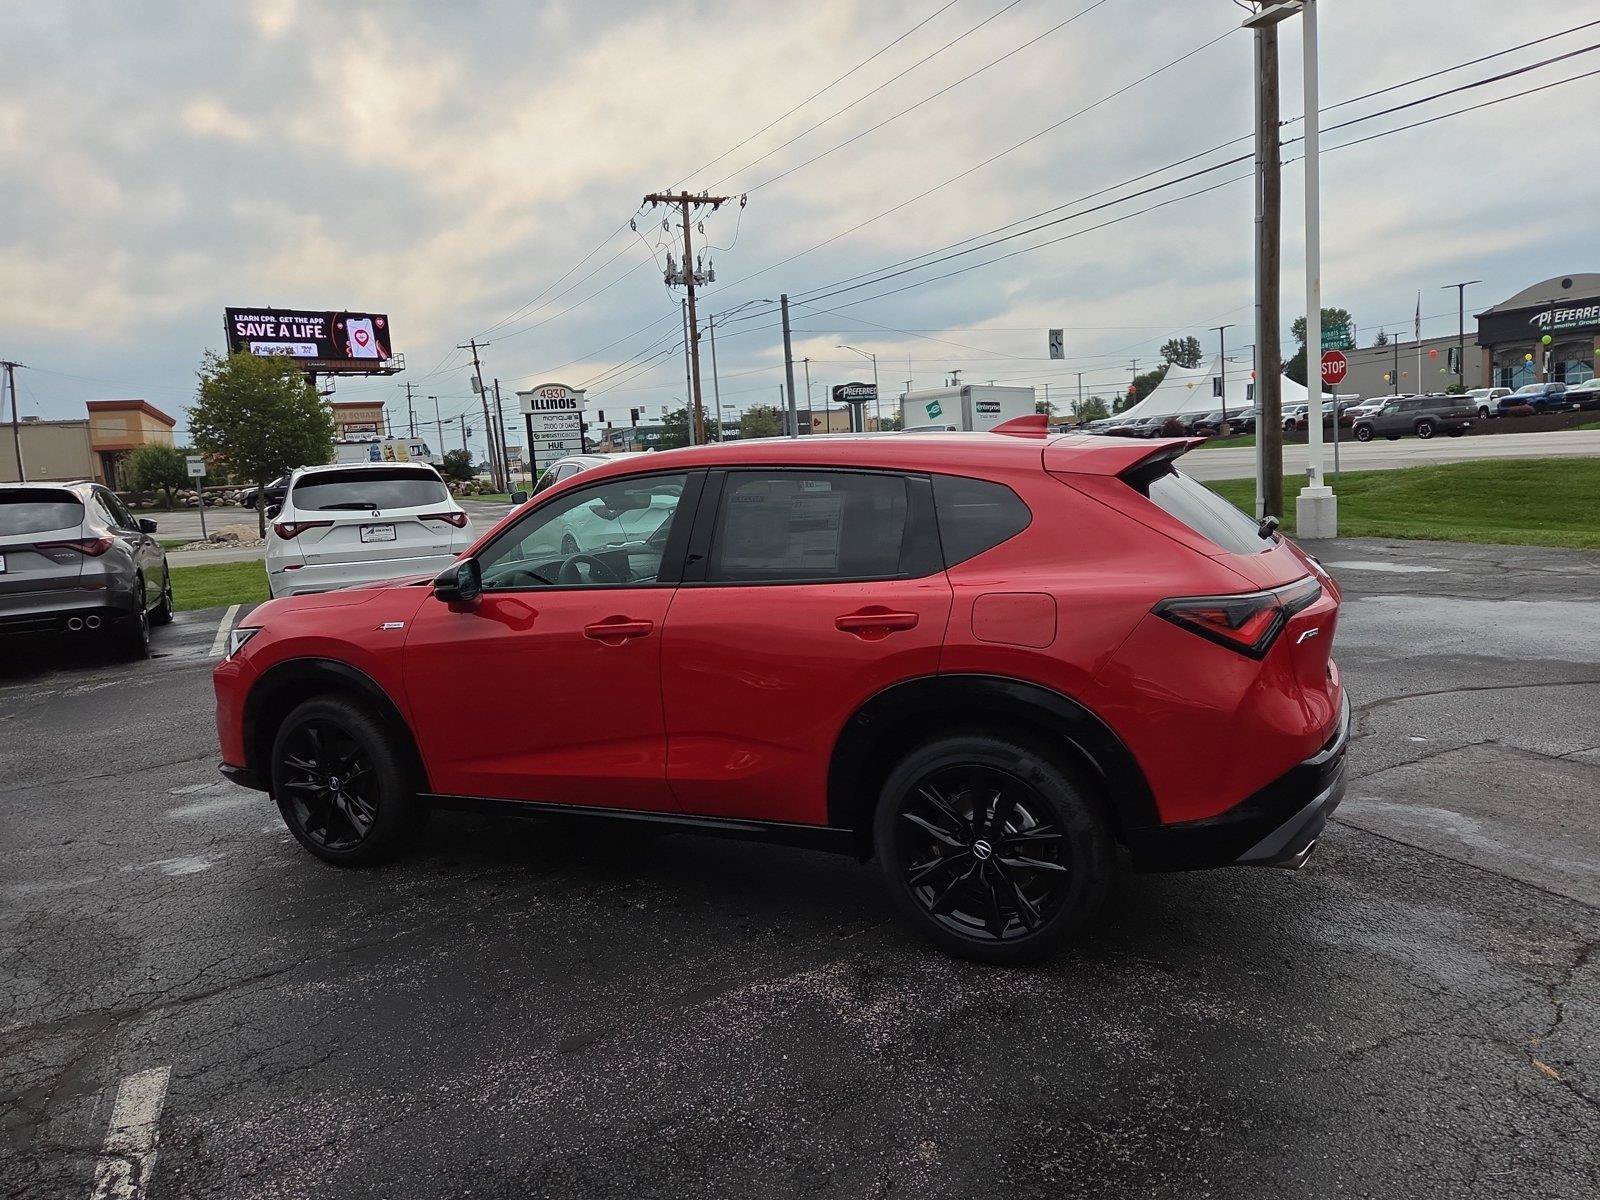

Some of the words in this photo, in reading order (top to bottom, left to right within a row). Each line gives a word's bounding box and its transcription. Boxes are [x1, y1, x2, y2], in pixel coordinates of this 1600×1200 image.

[234, 314, 261, 322] LEARN
[261, 315, 278, 323] CPR.
[294, 316, 308, 324] THE
[309, 317, 326, 325] APP.
[1537, 306, 1600, 327] PEFERRE
[236, 323, 278, 337] SAVE
[279, 324, 291, 337] A
[293, 324, 327, 339] LIFE.
[1542, 322, 1577, 331] Auomotive
[1321, 360, 1346, 375] STOP
[540, 388, 567, 399] 4930
[842, 386, 878, 399] PREFERRED
[530, 399, 577, 411] ILLINOIS
[977, 404, 1001, 412] enterprise
[348, 411, 381, 420] SQUARE
[565, 421, 580, 429] DANCE
